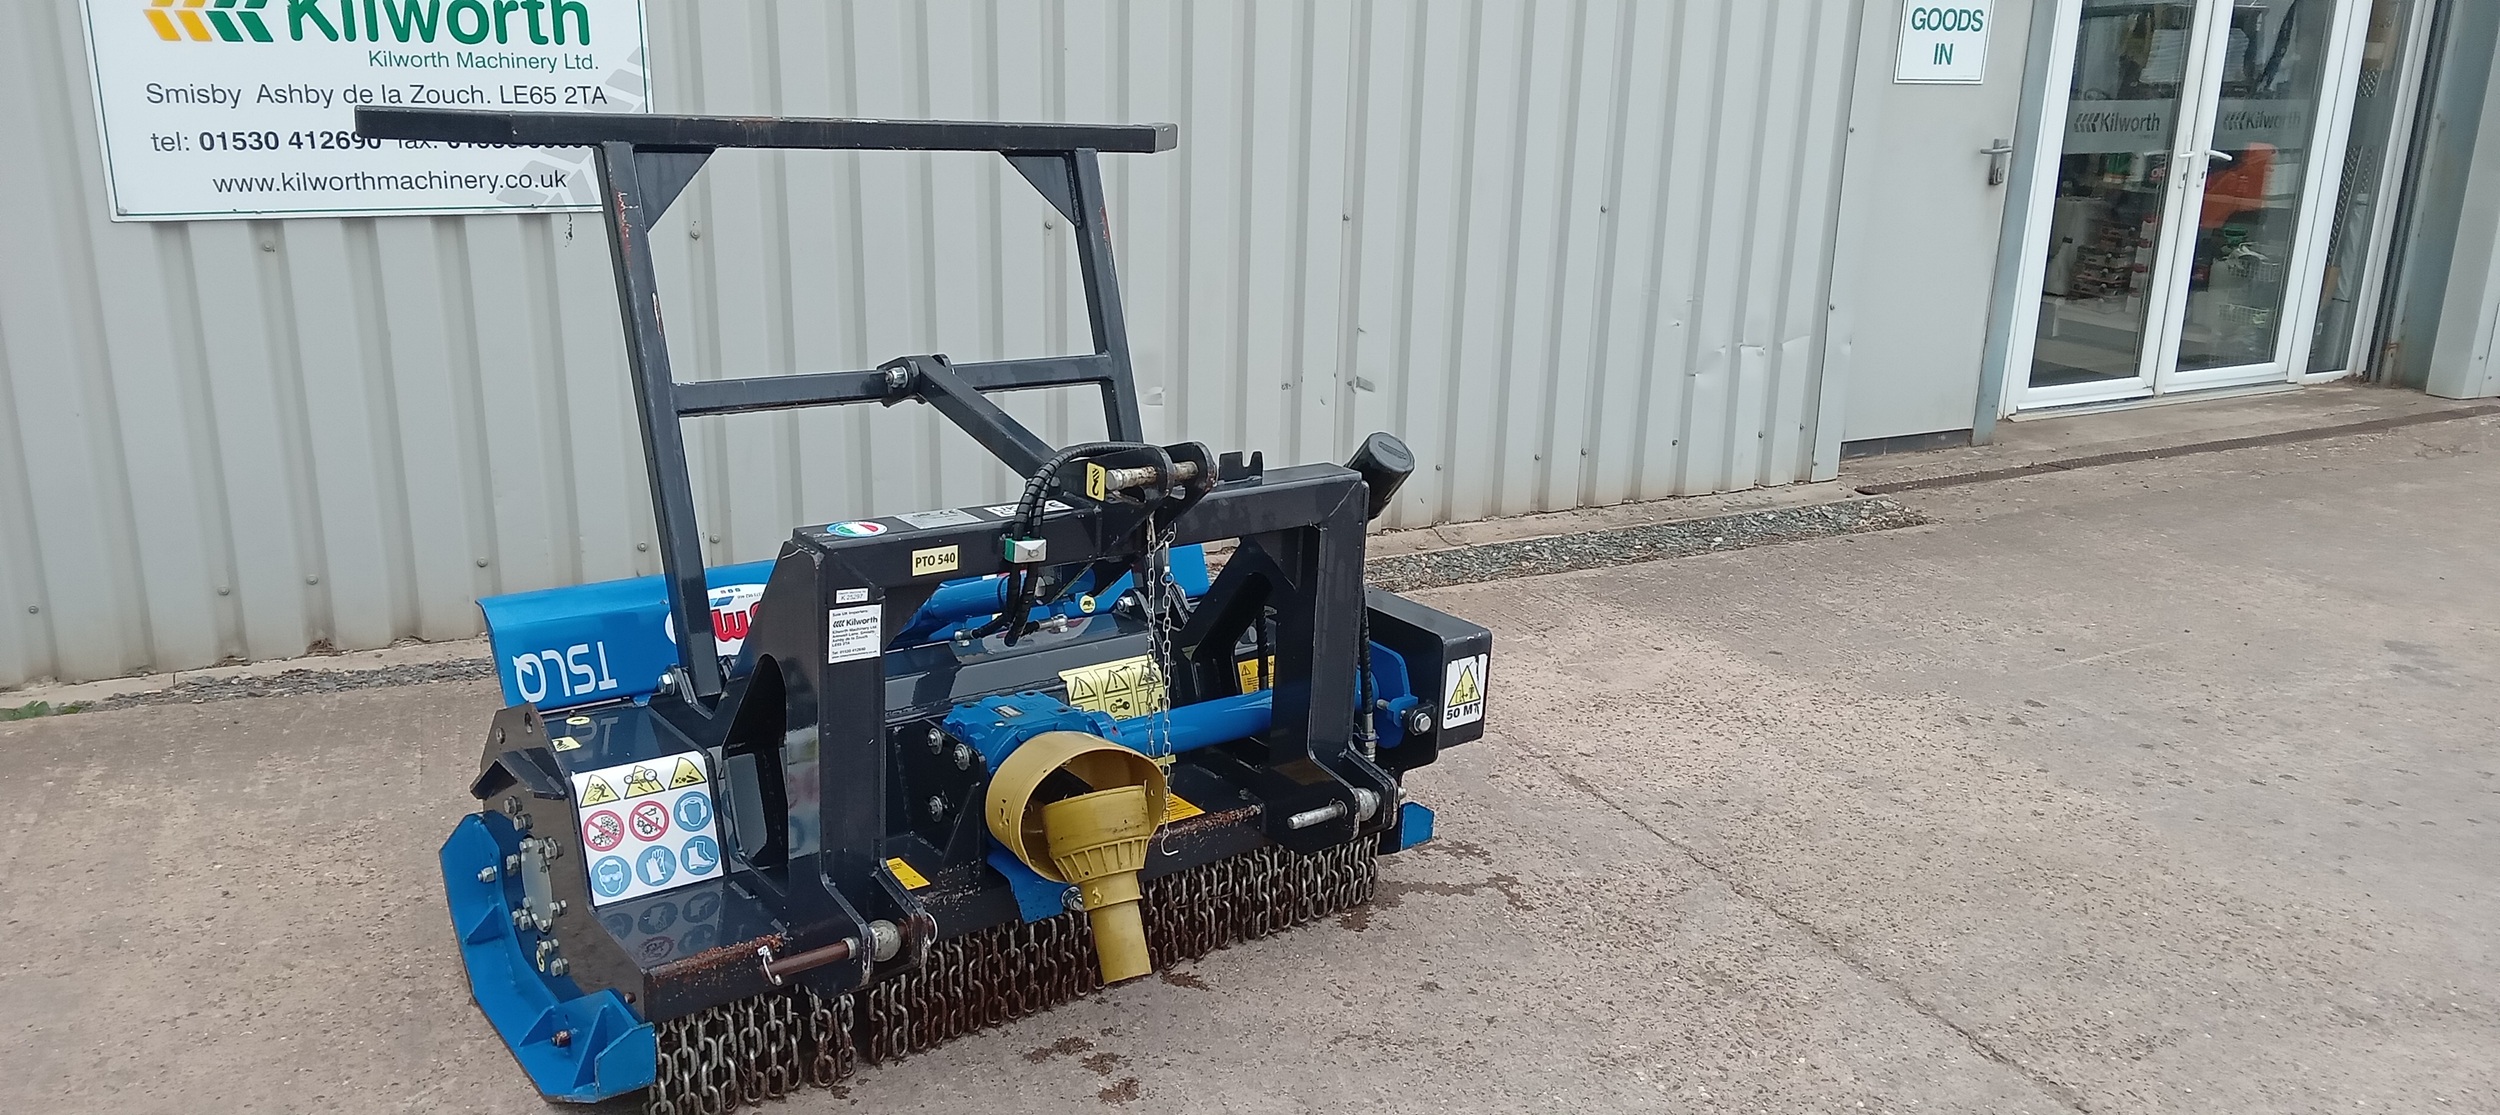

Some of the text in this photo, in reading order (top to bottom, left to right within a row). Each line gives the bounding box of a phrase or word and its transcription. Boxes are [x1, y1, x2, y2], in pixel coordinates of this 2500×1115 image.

[287, 0, 590, 45] Kilworth
[1912, 8, 1984, 32] GOODS
[369, 50, 598, 73] Kilworth Machinery Ltd.
[1934, 43, 1954, 65] IN
[146, 83, 608, 109] Smisby Ashby de la Zouch. LE65 2TA
[2100, 112, 2160, 133] Kilworth
[2246, 110, 2301, 130] Kilworth
[150, 132, 190, 151] tel:
[198, 131, 279, 150] 01530
[288, 130, 382, 150] 412690
[212, 170, 567, 194] www.kilworthmachinery.co.uk
[916, 552, 956, 568] PTO 540
[846, 616, 878, 626] Kilworth
[512, 641, 618, 702] TSLQ
[1446, 708, 1460, 720] 50
